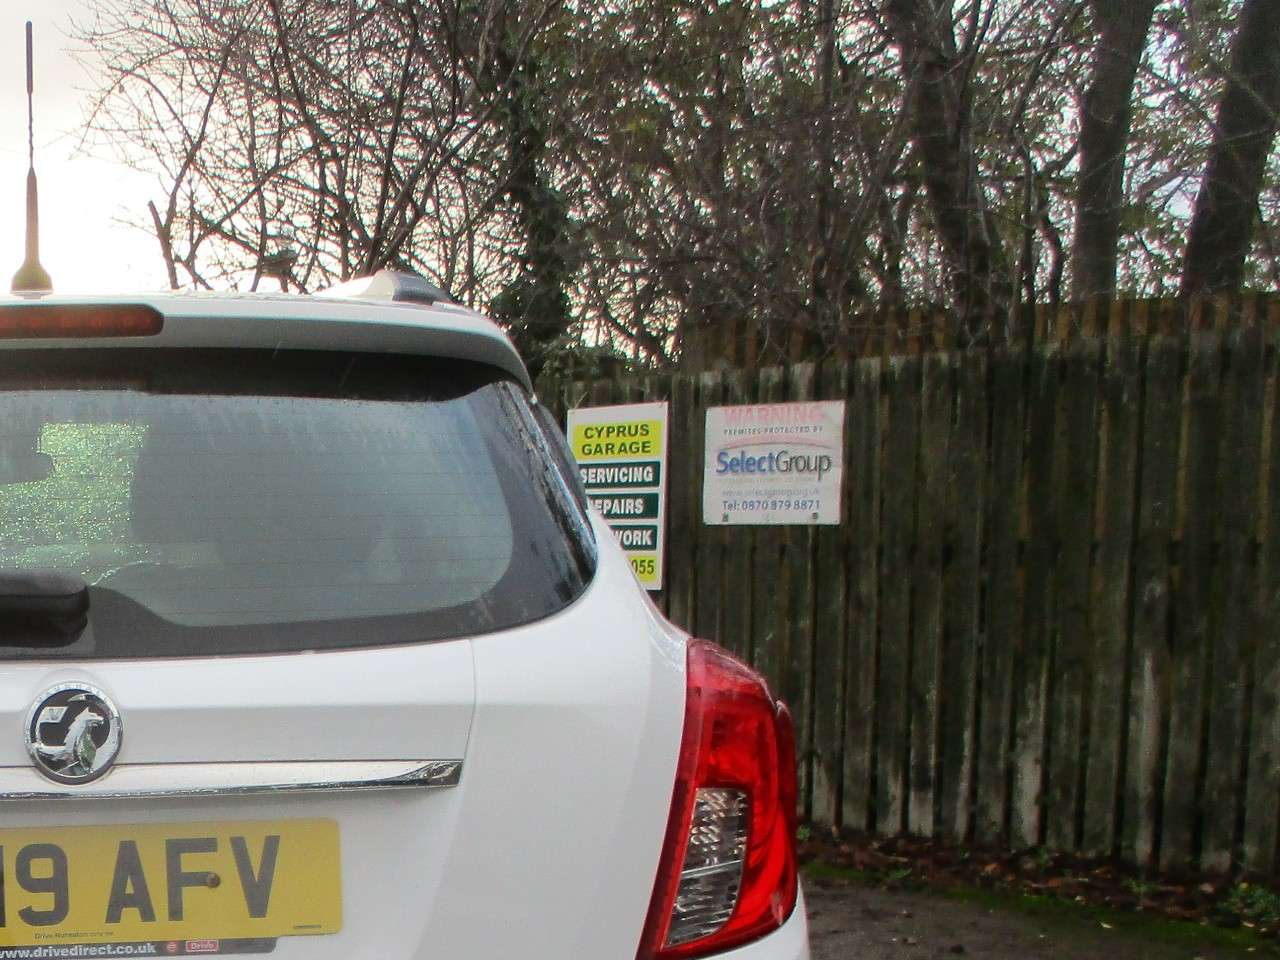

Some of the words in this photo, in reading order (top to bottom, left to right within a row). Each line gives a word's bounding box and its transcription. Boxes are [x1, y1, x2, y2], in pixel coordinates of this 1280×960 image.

[584, 423, 650, 440] CYPRUS
[764, 425, 809, 434] PROTECTED
[581, 440, 651, 457] GARAGE
[716, 450, 832, 480] SelectGroup
[580, 466, 654, 484] SERVICING
[722, 501, 740, 510] Tel:
[741, 500, 768, 511] 0870
[104, 834, 281, 924] AFV
[191, 941, 213, 951] Drive
